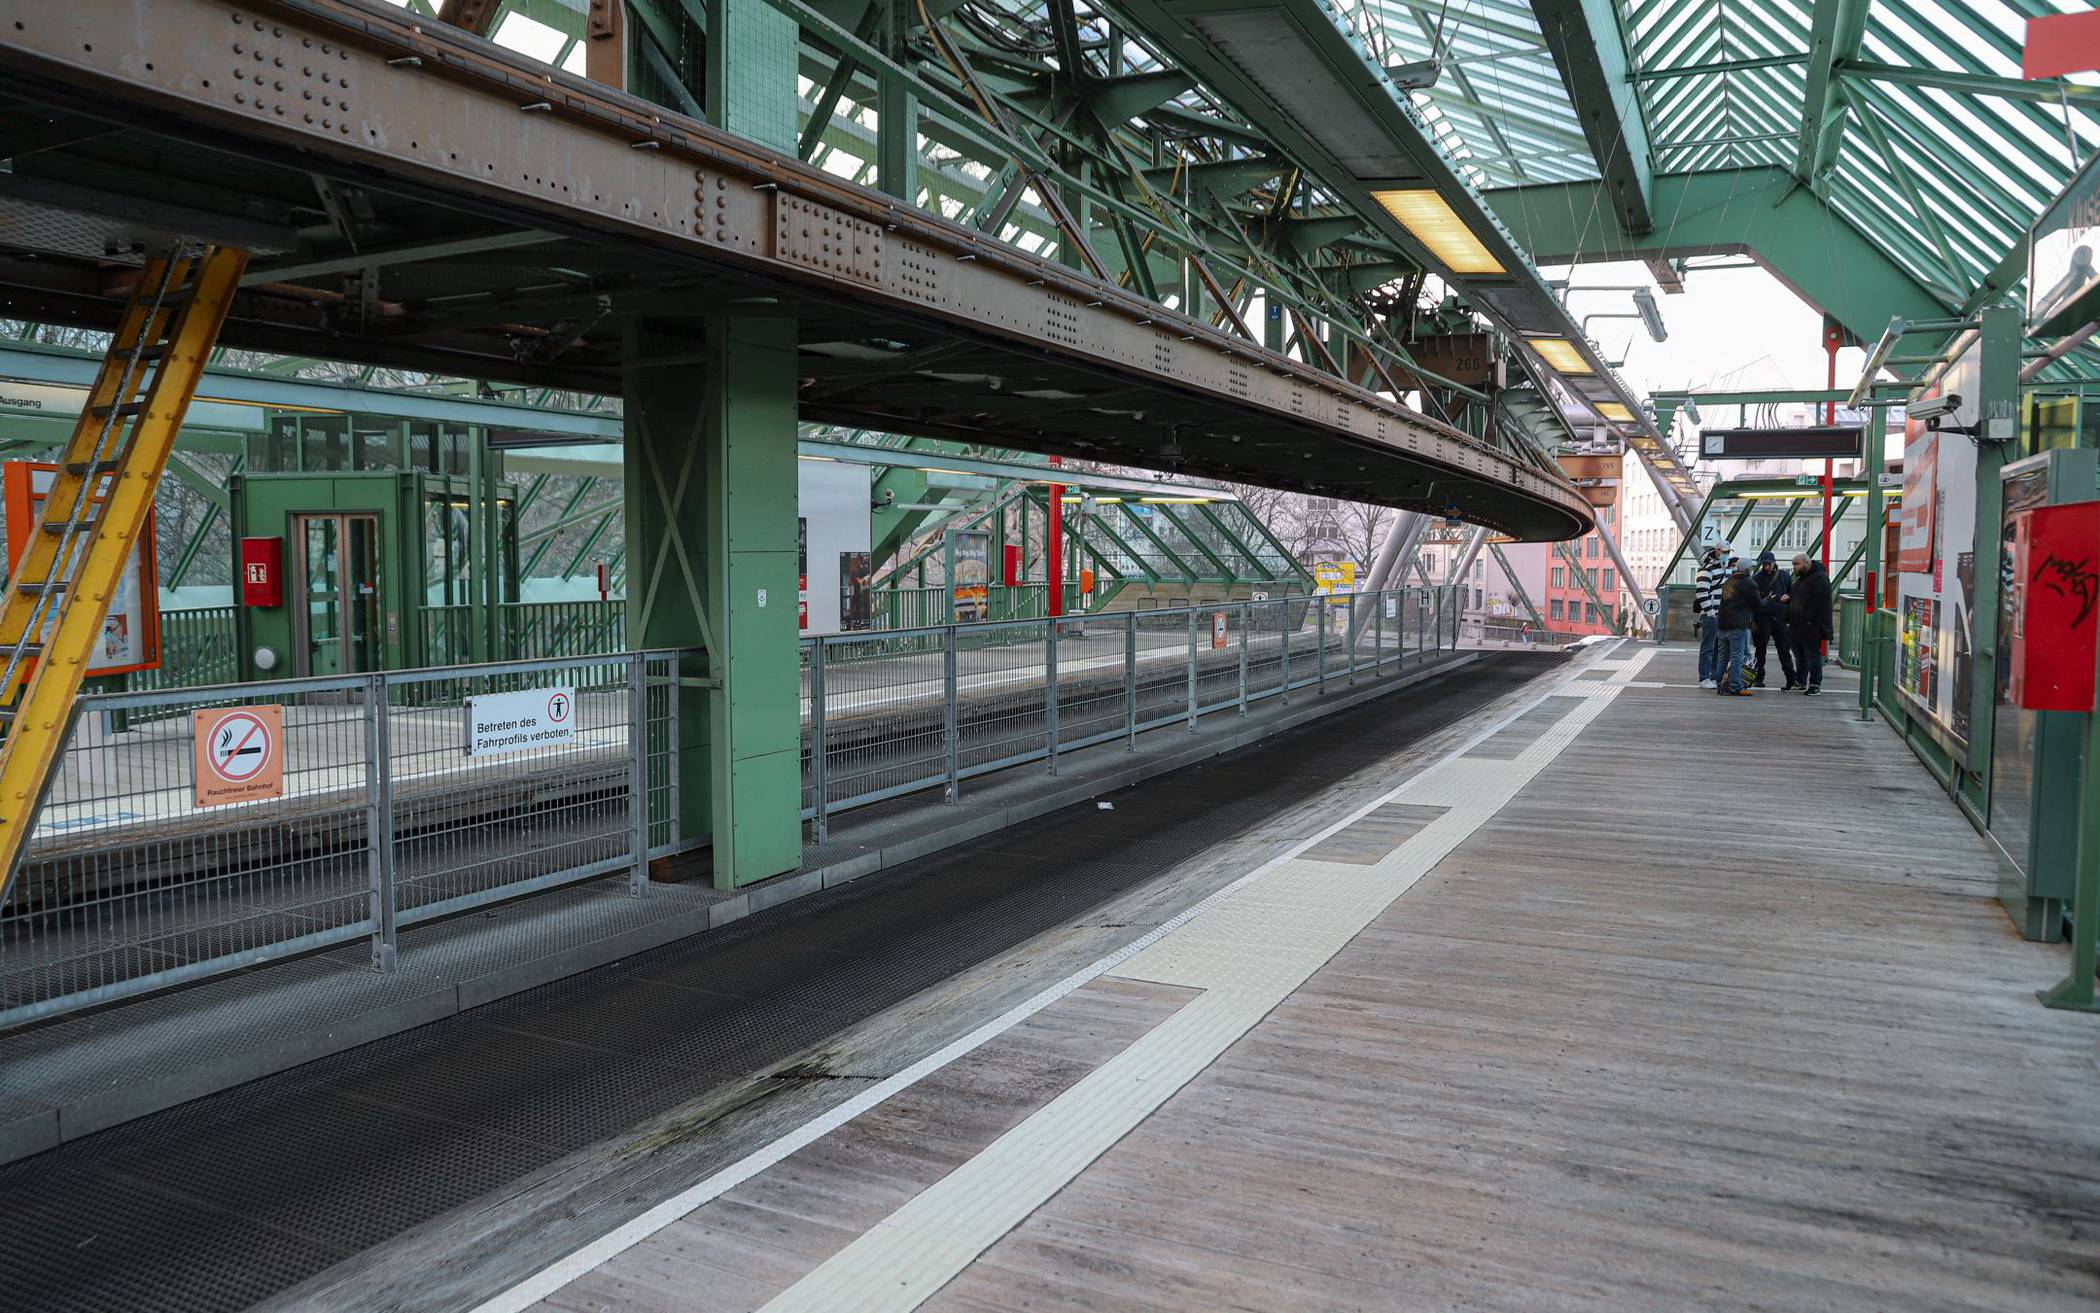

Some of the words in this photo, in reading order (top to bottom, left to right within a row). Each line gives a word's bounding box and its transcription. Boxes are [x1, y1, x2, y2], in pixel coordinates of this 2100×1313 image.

[1456, 358, 1480, 371] 266
[0, 396, 42, 409] Ausgang
[1704, 526, 1714, 540] Z
[477, 720, 517, 734] Betreten
[519, 717, 537, 728] des
[477, 733, 528, 749] Fahrprofils
[530, 728, 569, 741] verboten
[207, 786, 246, 796] Rauchfreier
[246, 782, 273, 792] Bahnhof
